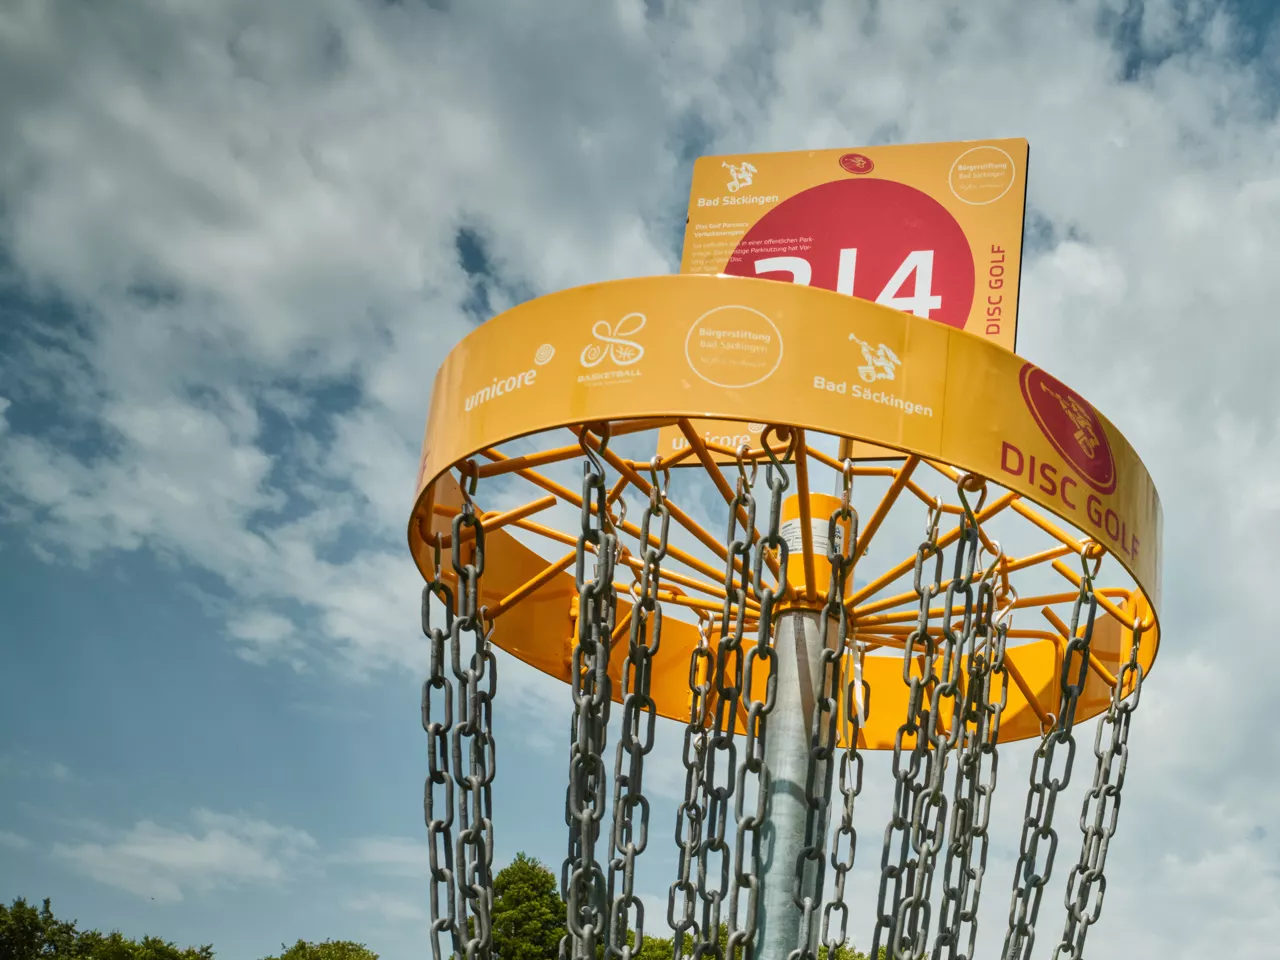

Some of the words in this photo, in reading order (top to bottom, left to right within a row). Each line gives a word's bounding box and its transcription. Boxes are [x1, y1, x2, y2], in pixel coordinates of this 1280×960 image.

[697, 197, 719, 207] Bad
[722, 194, 779, 206] Säckingen
[750, 246, 787, 254] Parknutzung
[988, 244, 1005, 290] GOLF
[985, 295, 1003, 335] DISC
[699, 327, 771, 344] Bürgerstiftung
[699, 339, 717, 348] Bad
[720, 341, 768, 354] Säckingen
[577, 369, 643, 383] BASKETBALL
[464, 368, 537, 412] umicore
[813, 375, 847, 394] Bad
[851, 384, 933, 418] Säckingen
[672, 431, 751, 450] uicore
[1001, 440, 1077, 511] DISC
[1086, 493, 1141, 561] GOLF
